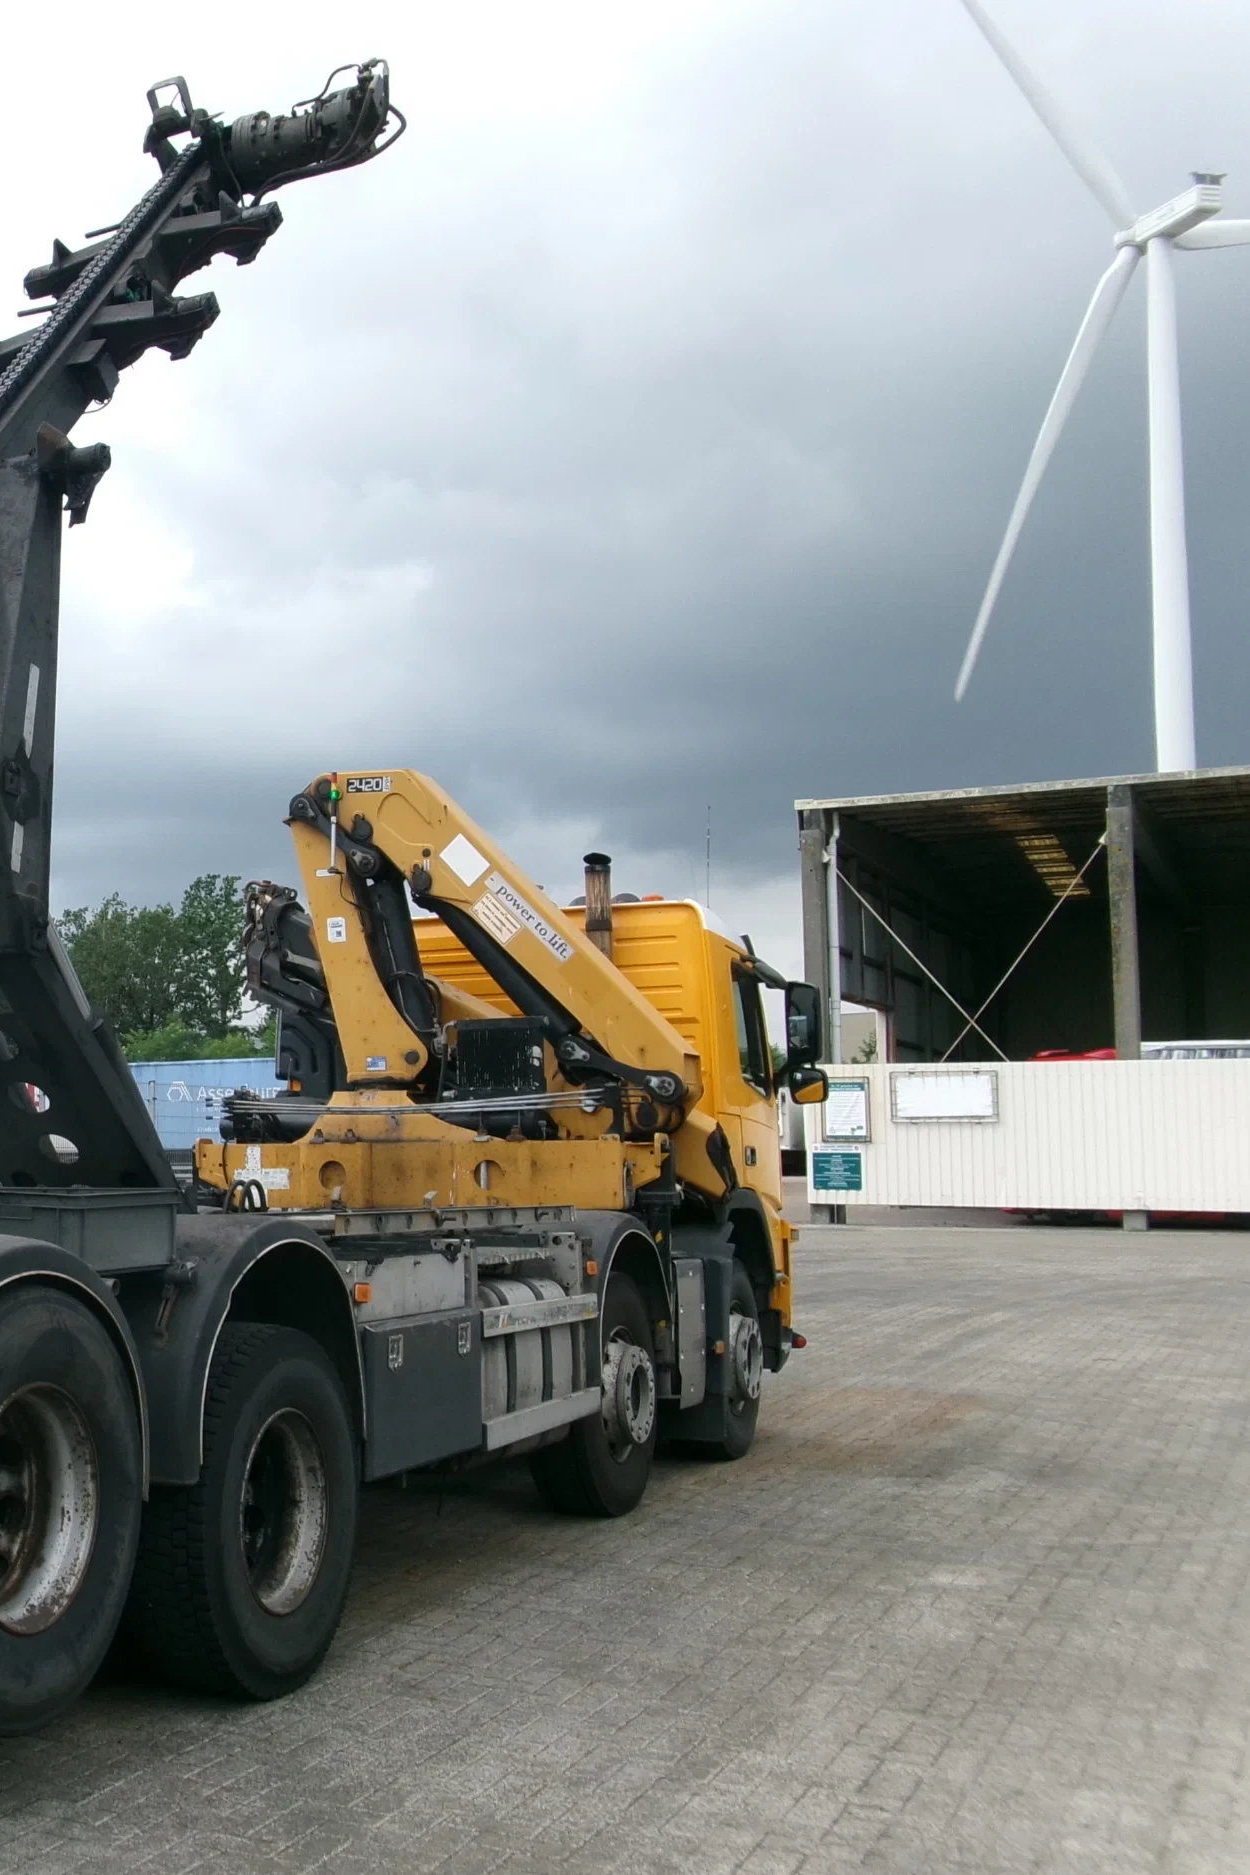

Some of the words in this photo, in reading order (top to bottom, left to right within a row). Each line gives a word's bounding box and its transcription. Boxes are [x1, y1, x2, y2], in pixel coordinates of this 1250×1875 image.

[348, 778, 382, 792] 2420
[496, 885, 535, 922] power
[534, 922, 548, 937] to
[196, 1082, 282, 1102] Asseur
